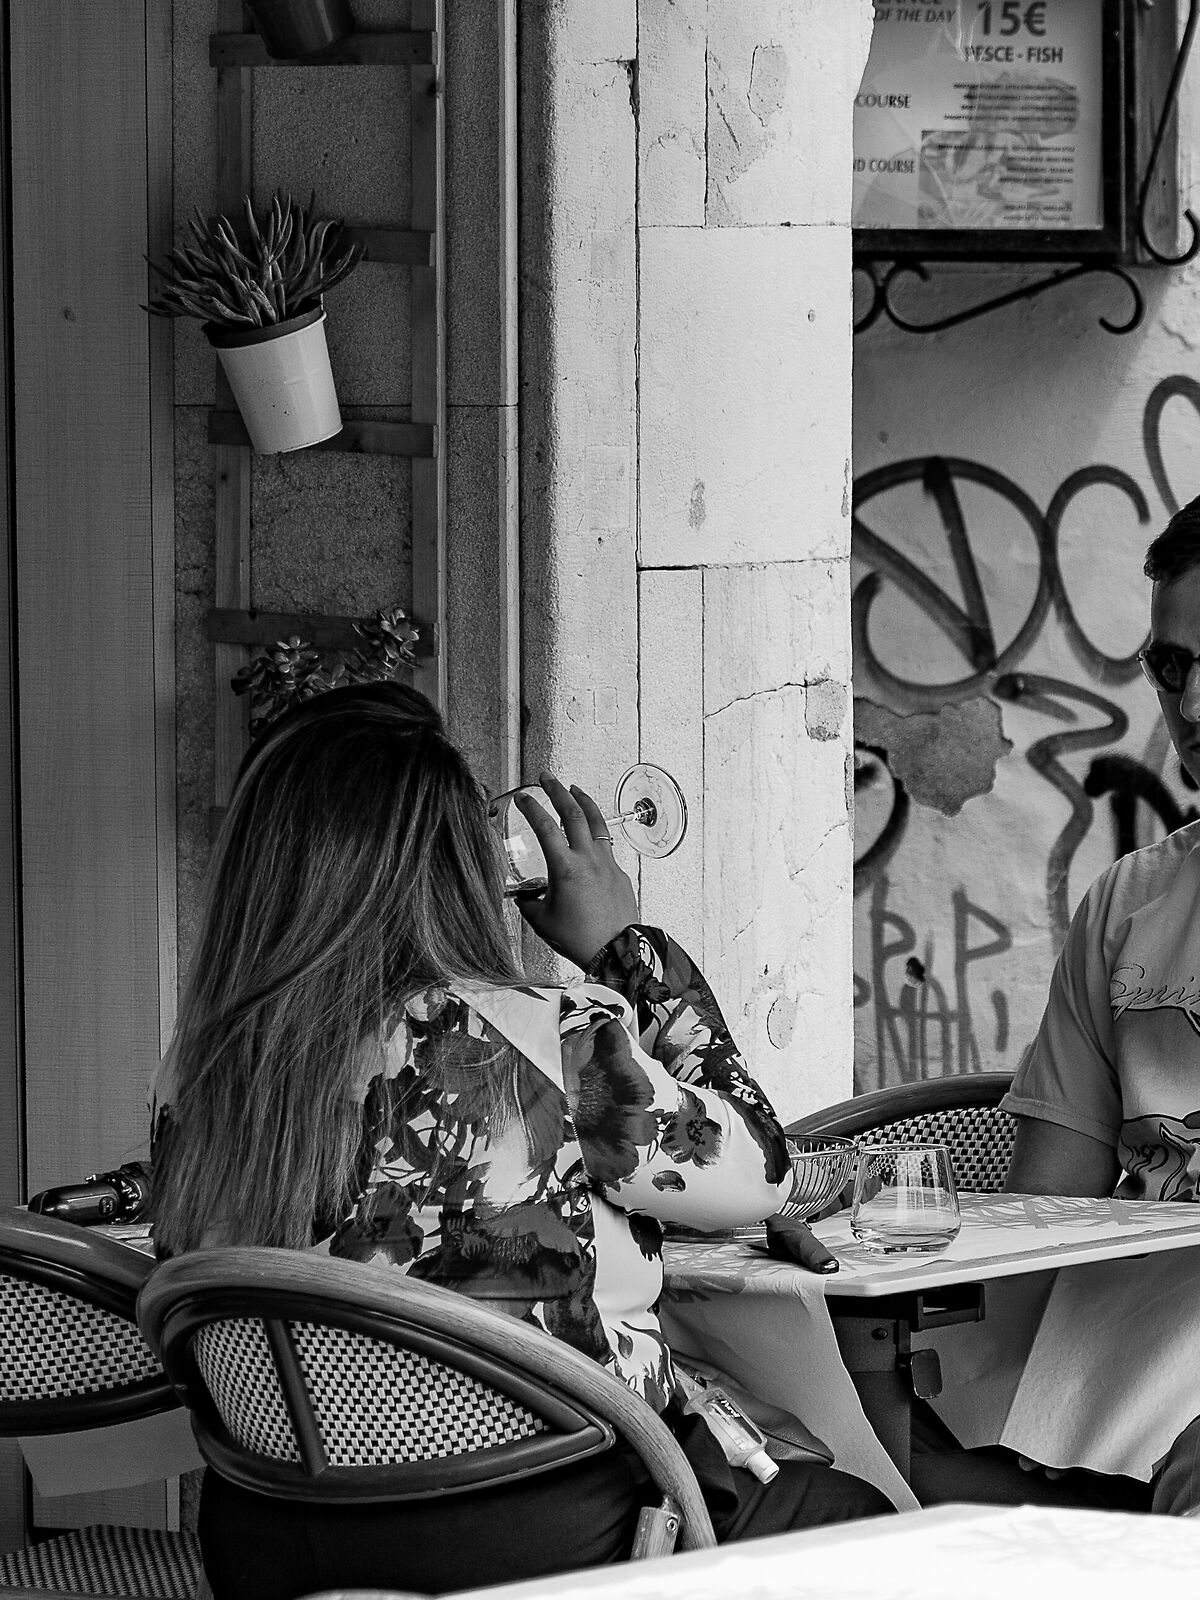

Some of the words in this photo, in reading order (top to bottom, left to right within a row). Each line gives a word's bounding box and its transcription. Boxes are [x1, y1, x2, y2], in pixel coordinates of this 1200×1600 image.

[897, 9, 923, 22] THE
[926, 9, 956, 23] DAY
[978, 1, 1046, 36] 15€
[1027, 47, 1064, 62] FISH
[855, 93, 911, 108] COURSE
[869, 160, 915, 173] COURSE
